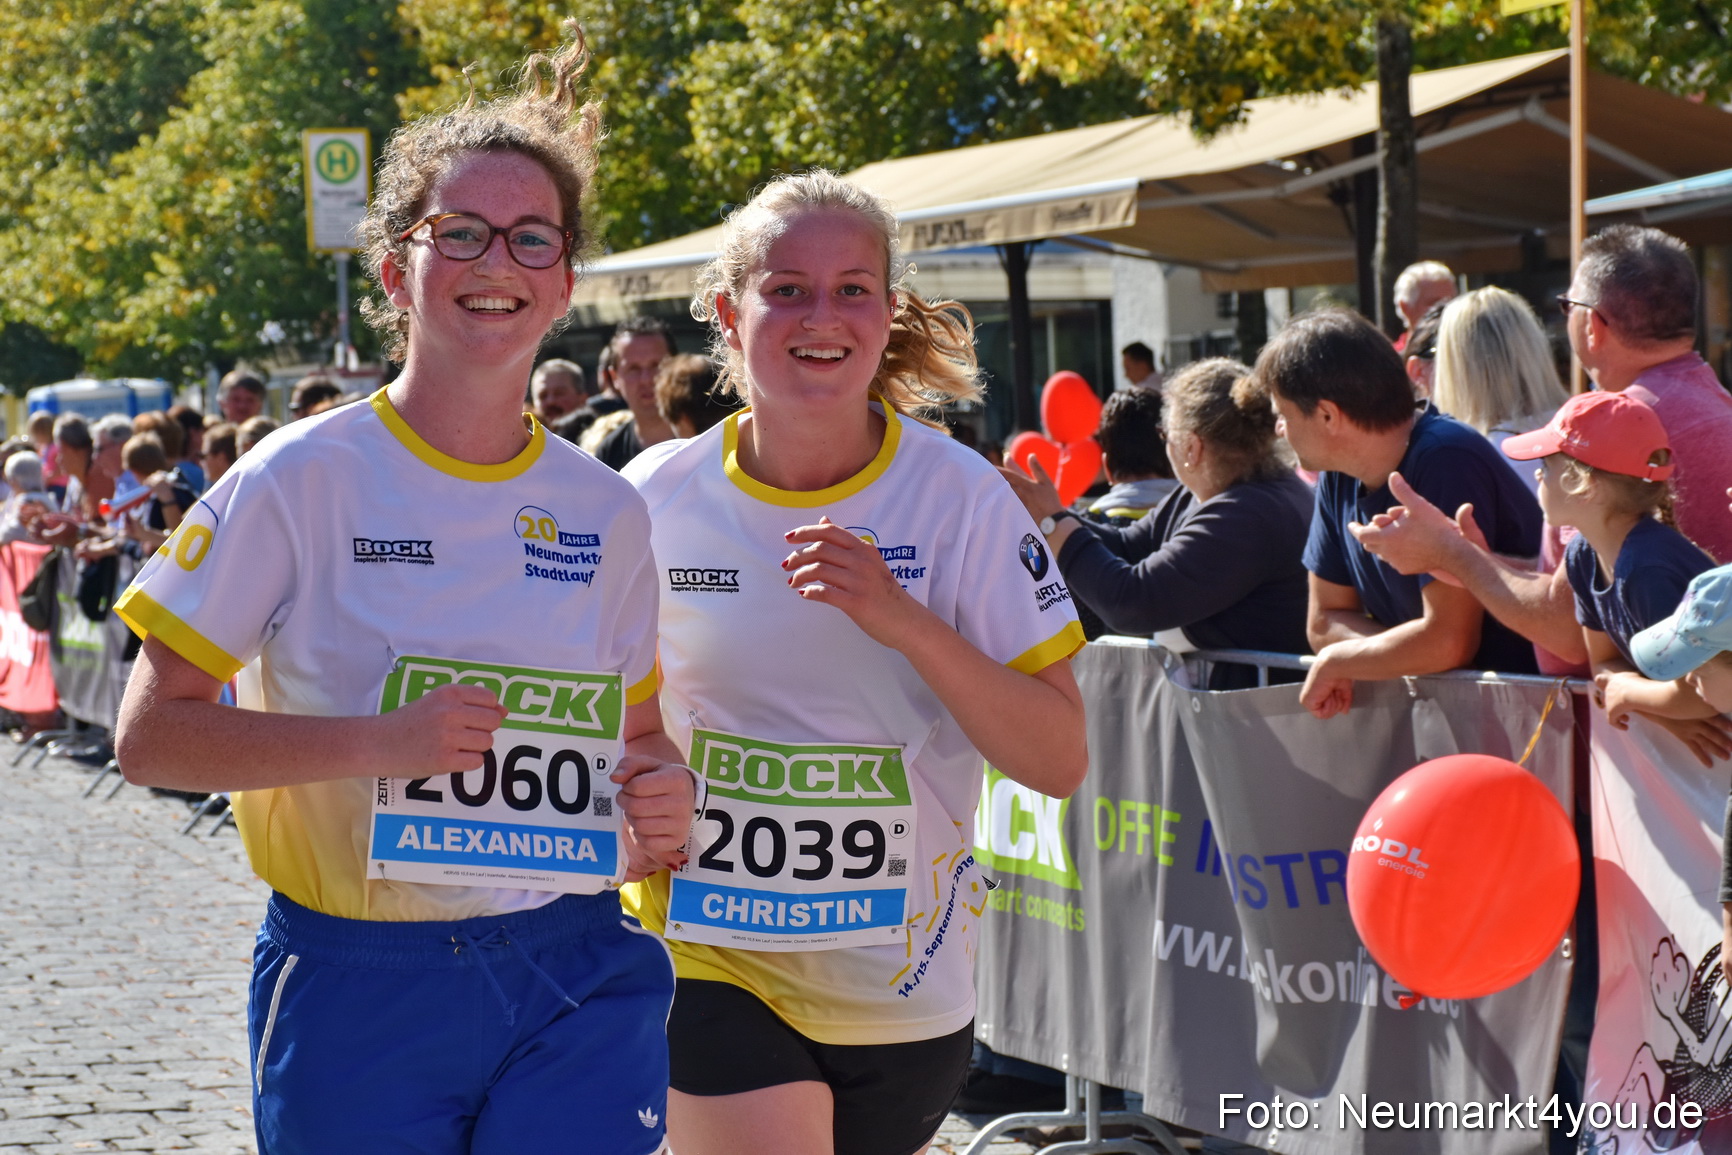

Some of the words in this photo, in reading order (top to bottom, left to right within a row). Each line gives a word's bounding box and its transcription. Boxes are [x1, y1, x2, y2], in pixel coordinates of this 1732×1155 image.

[519, 515, 556, 543] 20
[561, 534, 596, 545] JAHRE
[353, 538, 434, 558] BOCK
[354, 556, 379, 564] inspired
[525, 563, 595, 588] Stadtlauf
[669, 569, 739, 586] BOCK
[890, 565, 926, 579] rkter
[1034, 581, 1067, 603] ARTL
[596, 758, 606, 769] D
[703, 740, 894, 798] BOCK
[894, 823, 904, 834] D
[973, 777, 1067, 872] CK
[396, 825, 598, 862] ALEXANDRA
[699, 809, 886, 880] 2039
[1378, 857, 1425, 879] energie
[702, 893, 872, 927] CHRISTIN
[898, 959, 930, 998] 14./15.
[924, 884, 957, 959] September
[952, 855, 975, 884] 2019
